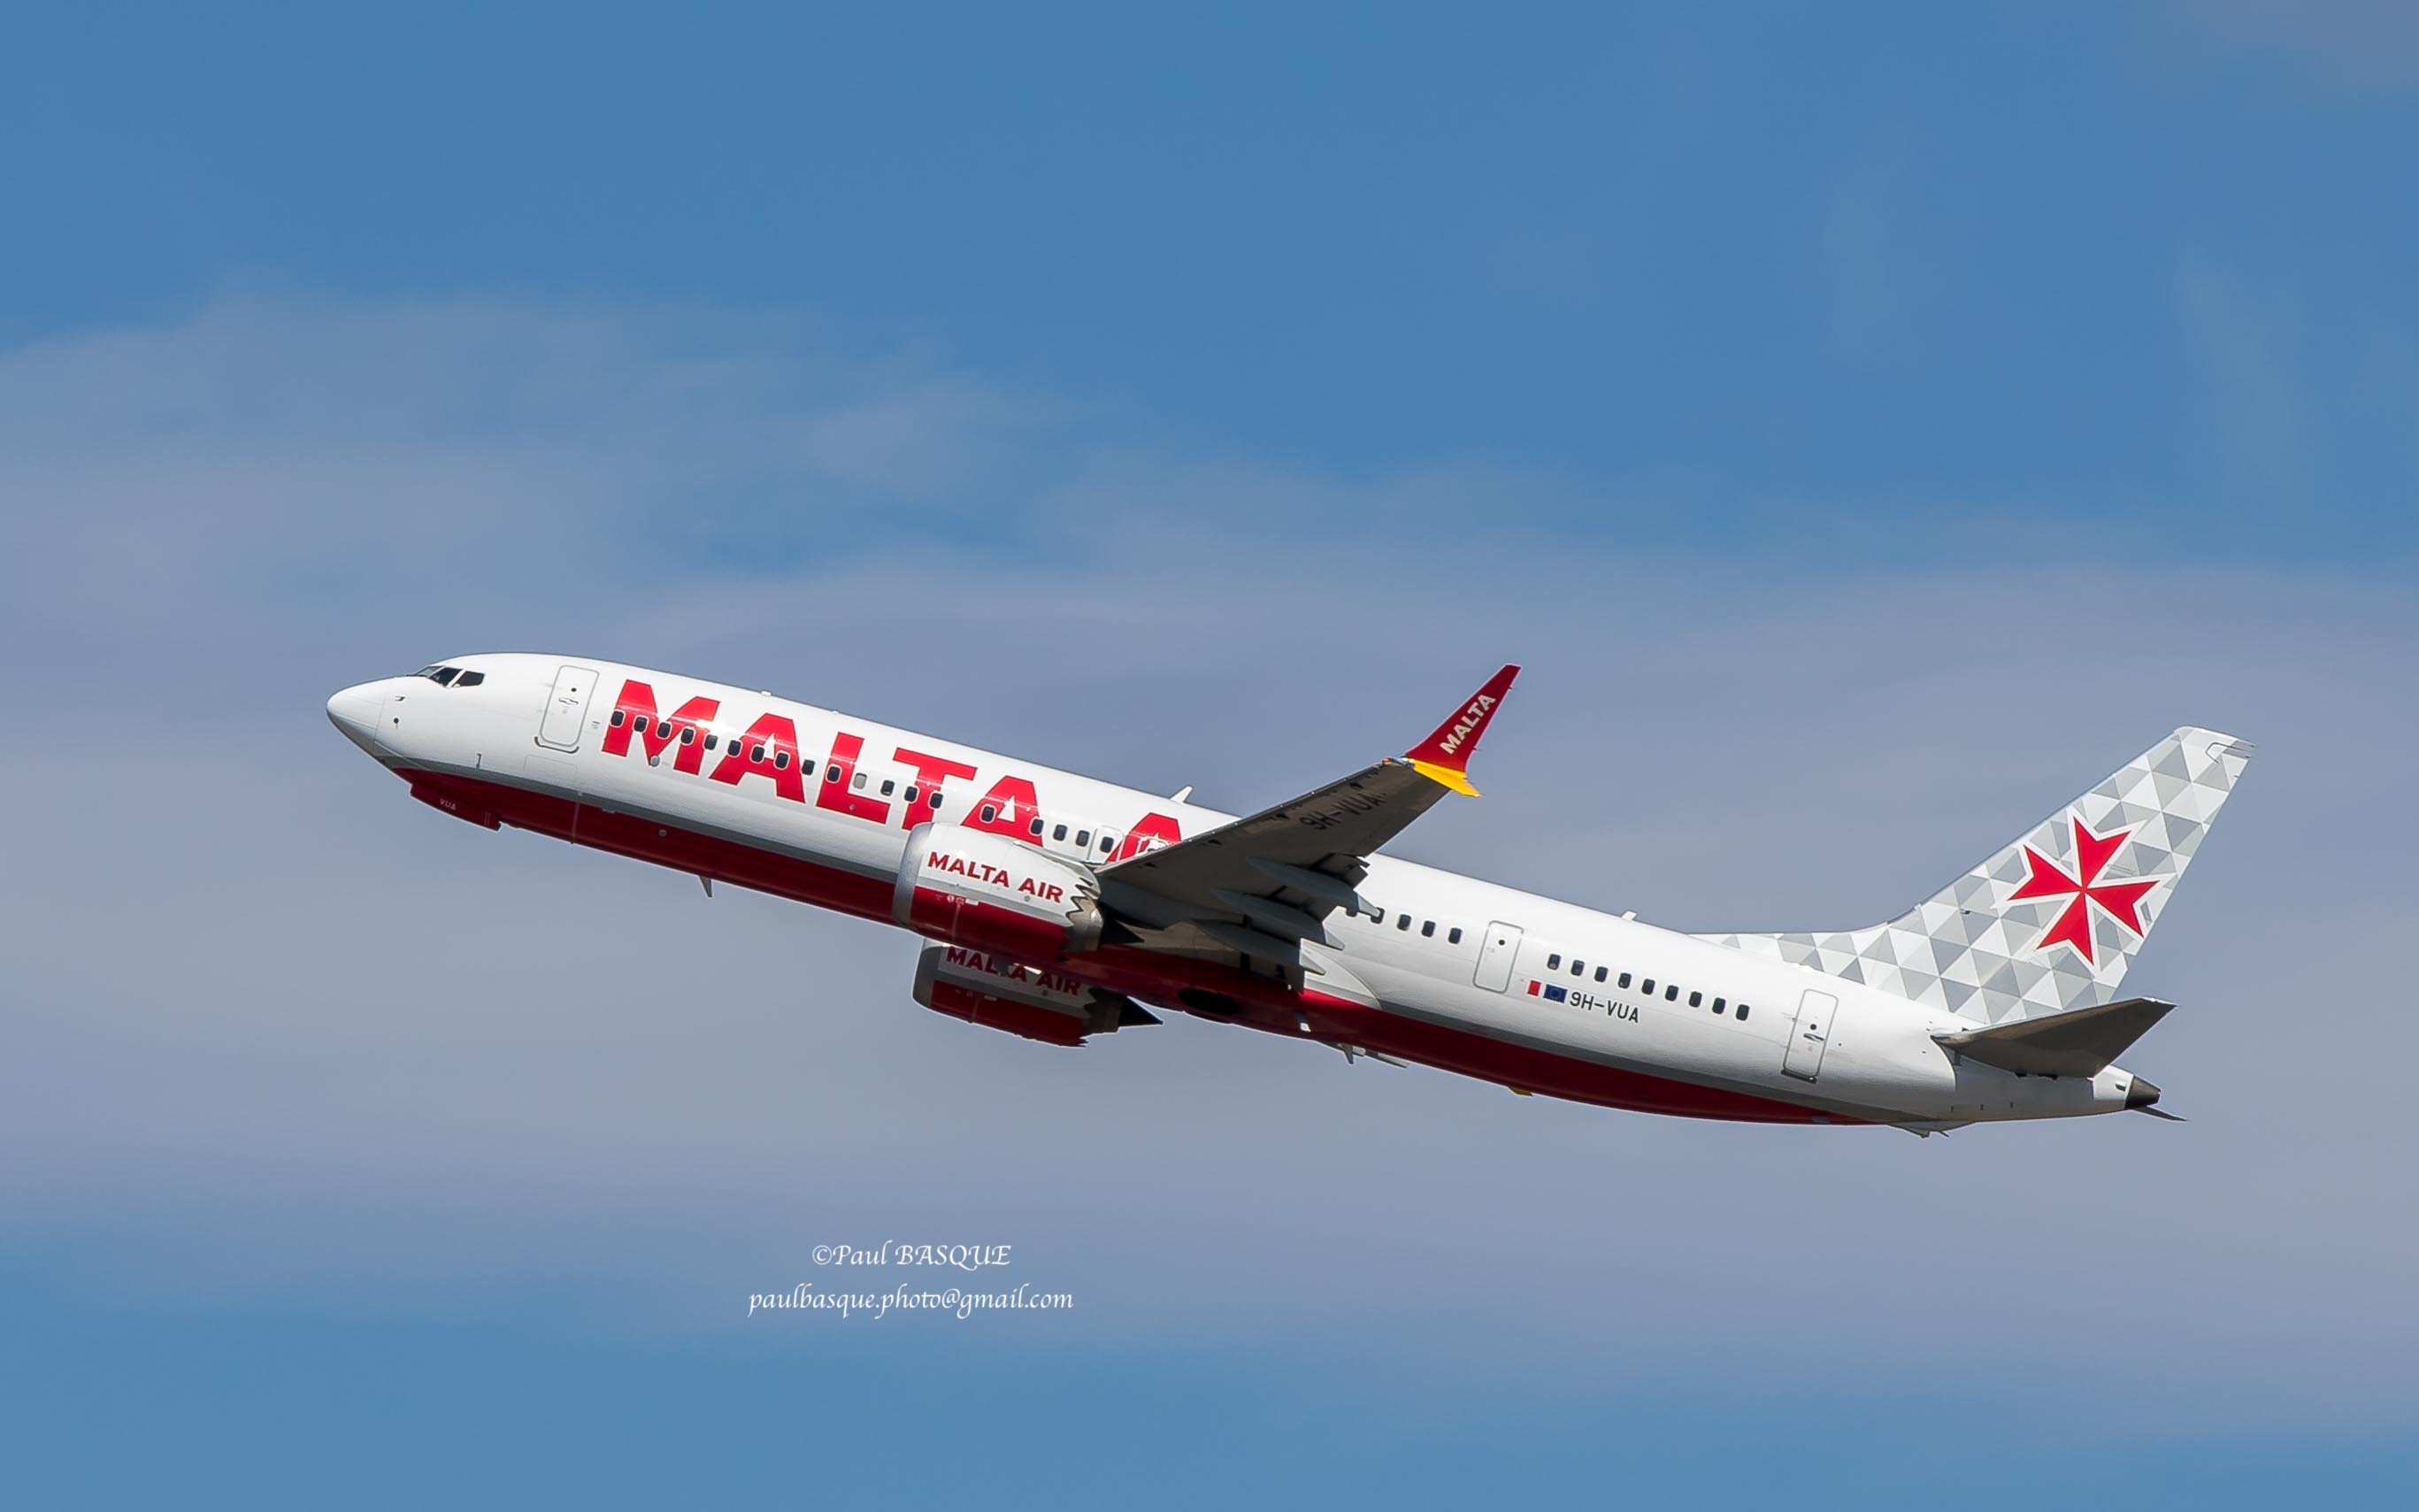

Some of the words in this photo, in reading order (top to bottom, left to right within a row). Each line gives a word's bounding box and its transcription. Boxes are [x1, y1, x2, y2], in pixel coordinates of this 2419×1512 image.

[1439, 695, 1496, 755] MALTA
[602, 679, 1043, 848] MALTA
[1299, 793, 1386, 830] 9H-VUA
[927, 851, 1010, 888] MALTA
[1018, 877, 1064, 903] AIR
[946, 945, 1028, 983] MALA
[1035, 972, 1081, 996] AIR
[1570, 991, 1639, 1023] 9H-VUA
